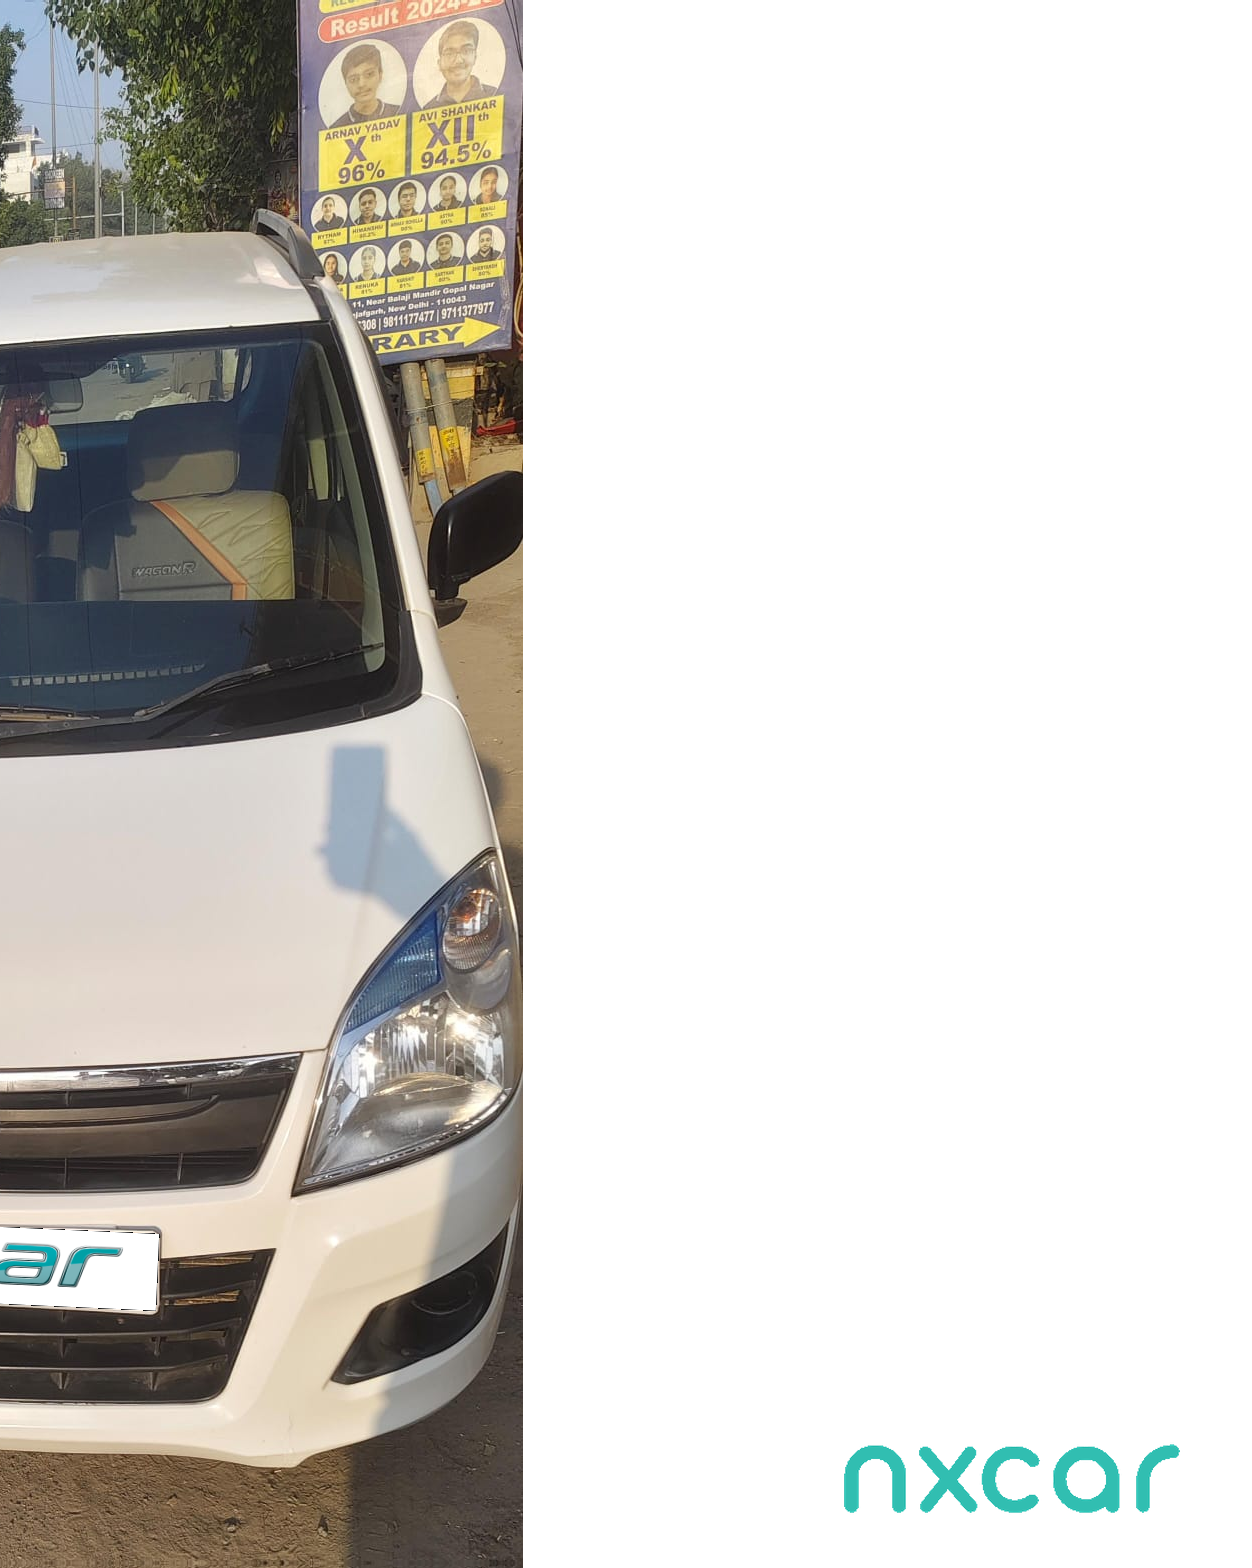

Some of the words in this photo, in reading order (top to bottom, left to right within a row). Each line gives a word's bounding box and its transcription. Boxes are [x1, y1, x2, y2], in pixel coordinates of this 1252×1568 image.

[330, 8, 398, 38] Result
[419, 111, 438, 123] AVI
[441, 100, 497, 118] SHANKAR
[325, 126, 361, 142] ARNAV
[365, 118, 400, 133] YADAV
[421, 141, 491, 169] 94.5%
[339, 160, 385, 185] 96%
[366, 298, 386, 307] Near
[388, 294, 411, 303] Balaji
[412, 289, 441, 300] Mandir
[443, 285, 467, 296] Gopal
[469, 282, 495, 293] Nagar
[388, 304, 407, 313] New
[408, 301, 429, 311] Delhi
[437, 295, 467, 306] 110043
[383, 310, 435, 328] 9811177477
[441, 301, 495, 320] 9711377977
[371, 326, 464, 351] RARY
